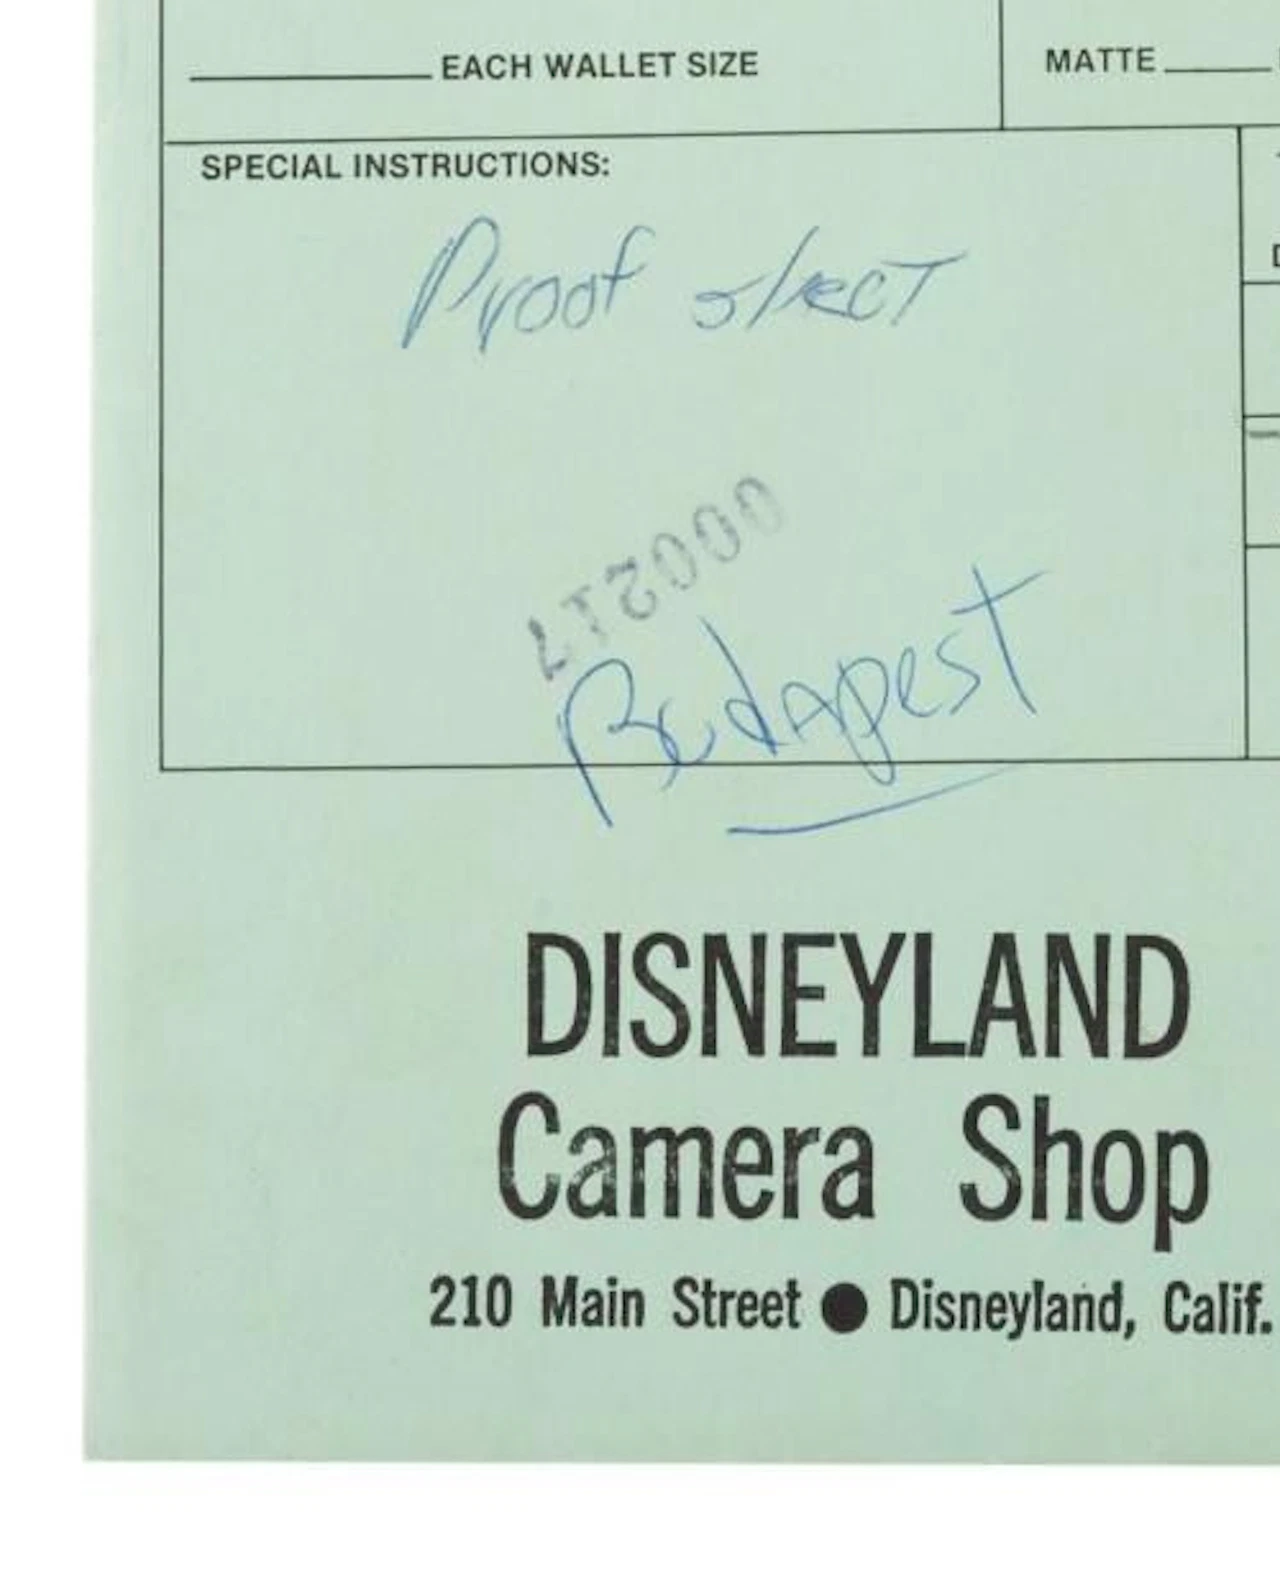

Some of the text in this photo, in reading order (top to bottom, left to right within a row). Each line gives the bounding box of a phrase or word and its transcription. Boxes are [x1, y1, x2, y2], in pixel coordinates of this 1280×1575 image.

[441, 50, 759, 81] EACH WALLET SIZE
[1045, 46, 1156, 74] MATTE
[200, 150, 610, 181] SPECIAL INSTRUCTIONS:
[402, 214, 655, 354] Proof
[526, 931, 1191, 1060] DISNEYLAND
[497, 1090, 1210, 1254] Camera Shop
[429, 1273, 1274, 1342] 210 Main Street Disneyland, Calif.
